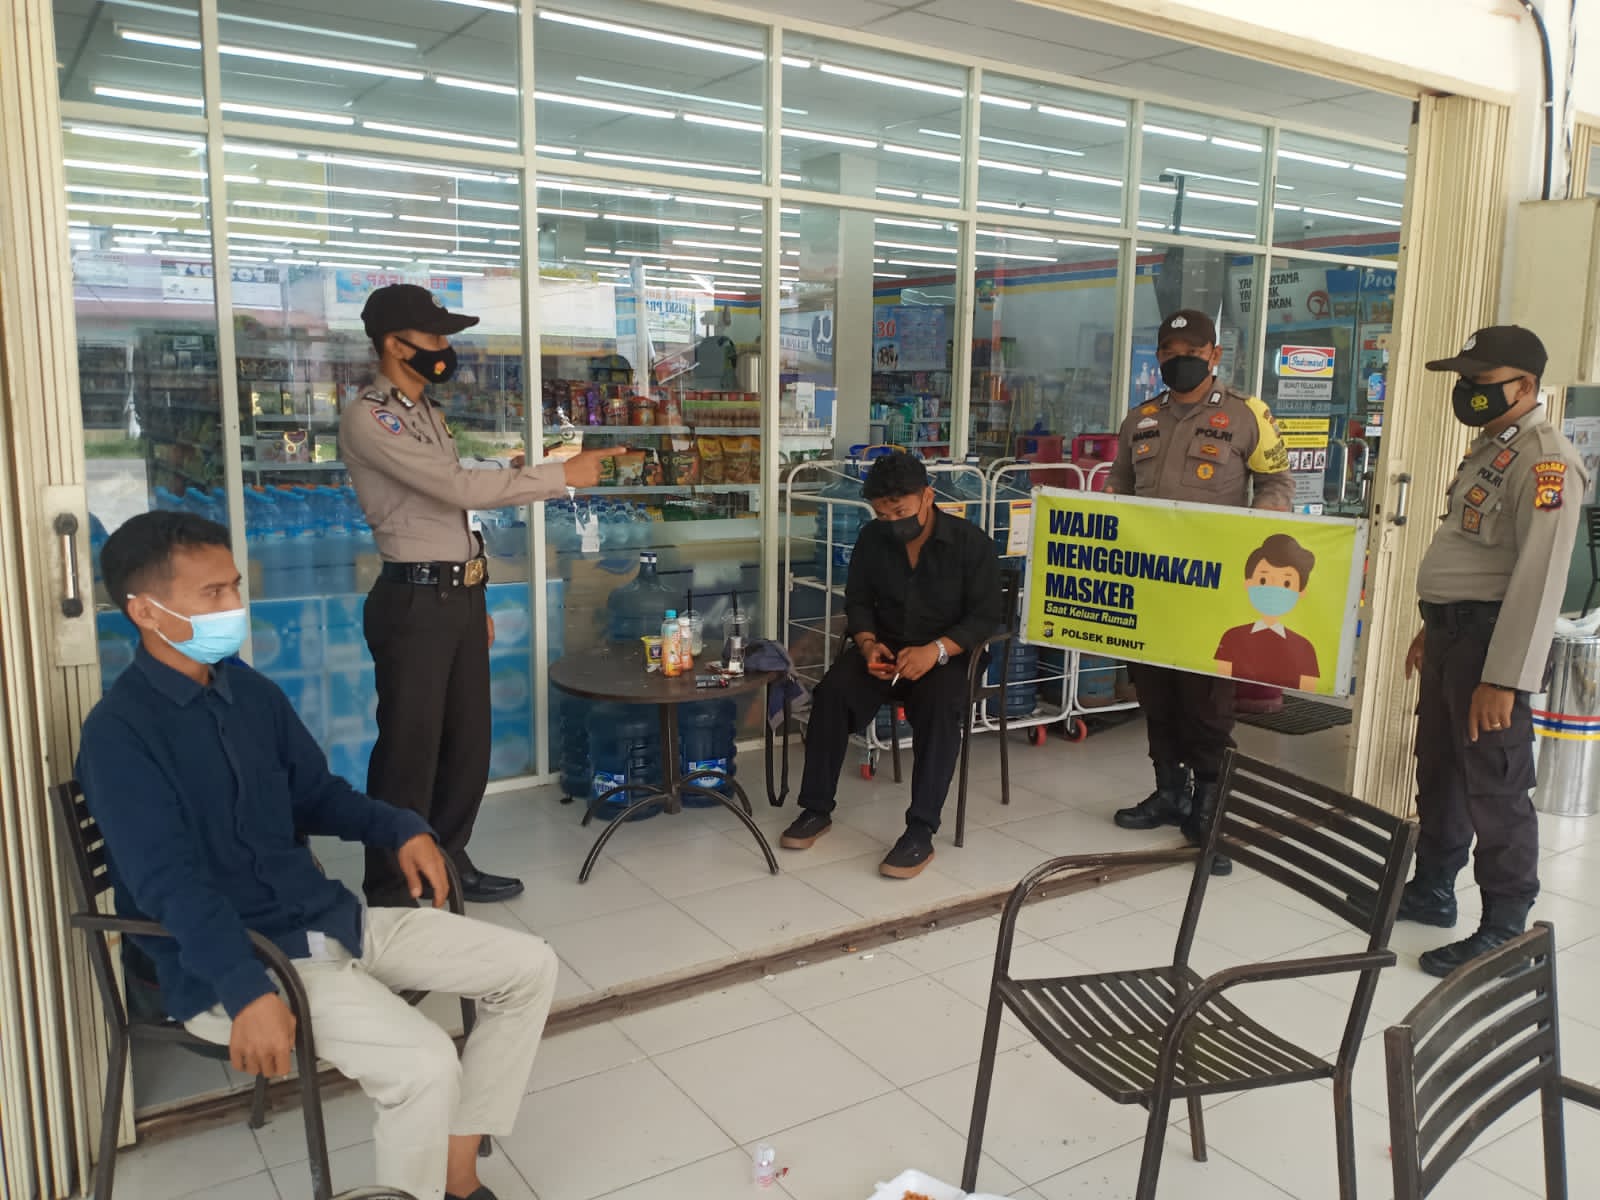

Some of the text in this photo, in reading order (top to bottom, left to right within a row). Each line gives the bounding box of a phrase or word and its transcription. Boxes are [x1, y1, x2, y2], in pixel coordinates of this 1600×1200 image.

[876, 319, 896, 337] 30
[1195, 428, 1233, 442] POLRI
[1477, 467, 1504, 488] POLRI
[1049, 509, 1119, 541] WAJIB
[1047, 541, 1222, 589] MENGGUNAKAN
[1045, 573, 1135, 610] MASKER
[1046, 602, 1135, 627] Saat Keluar Rumah
[1061, 628, 1145, 651] POLSEK BUNUT
